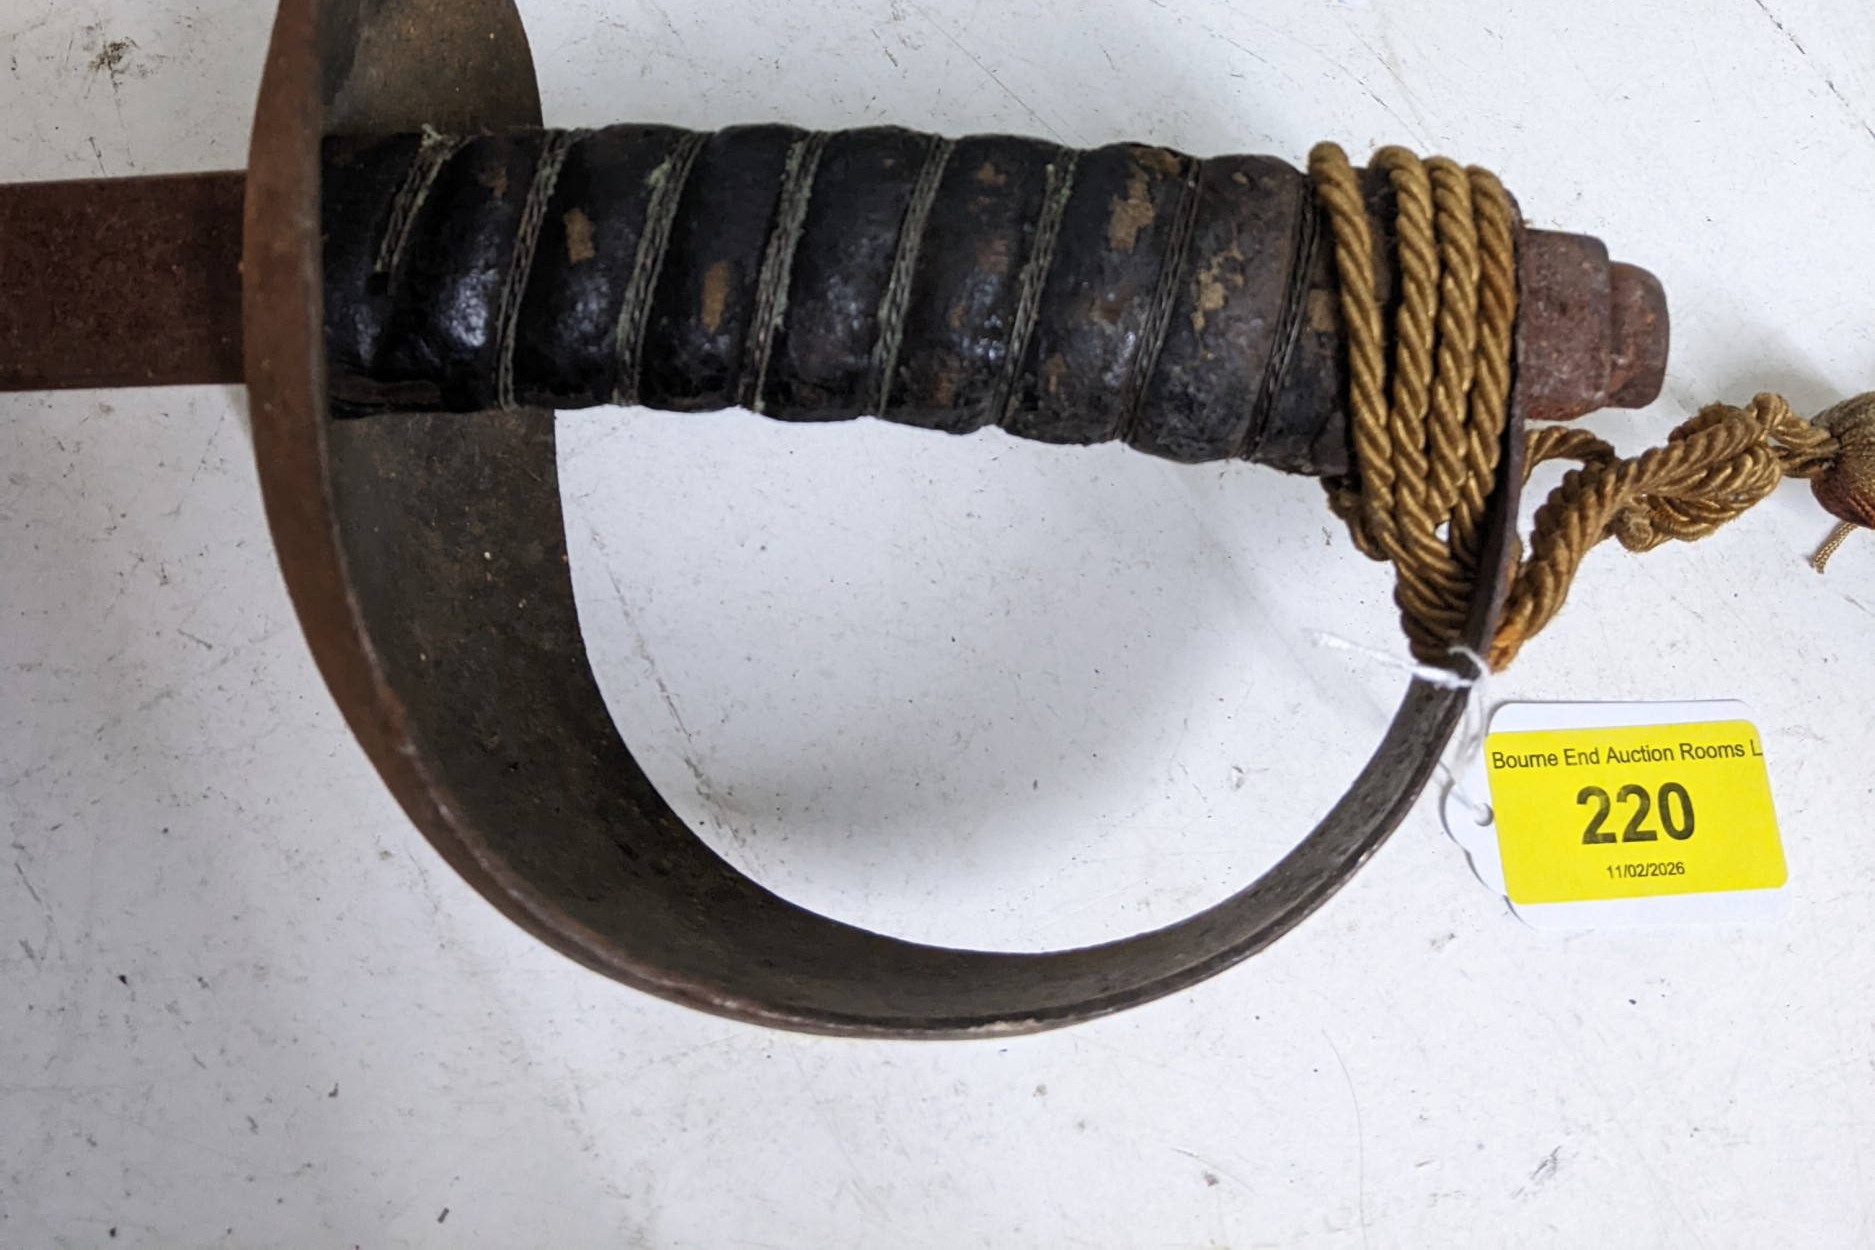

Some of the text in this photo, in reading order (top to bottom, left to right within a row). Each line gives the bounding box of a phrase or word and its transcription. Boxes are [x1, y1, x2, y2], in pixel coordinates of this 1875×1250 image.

[1491, 750, 1559, 769] Bourne
[1563, 747, 1600, 766] End
[1606, 744, 1675, 764] Auction
[1679, 741, 1746, 761] Rooms
[1576, 781, 1696, 845] 220
[1606, 861, 1686, 879] 11/02/2026
